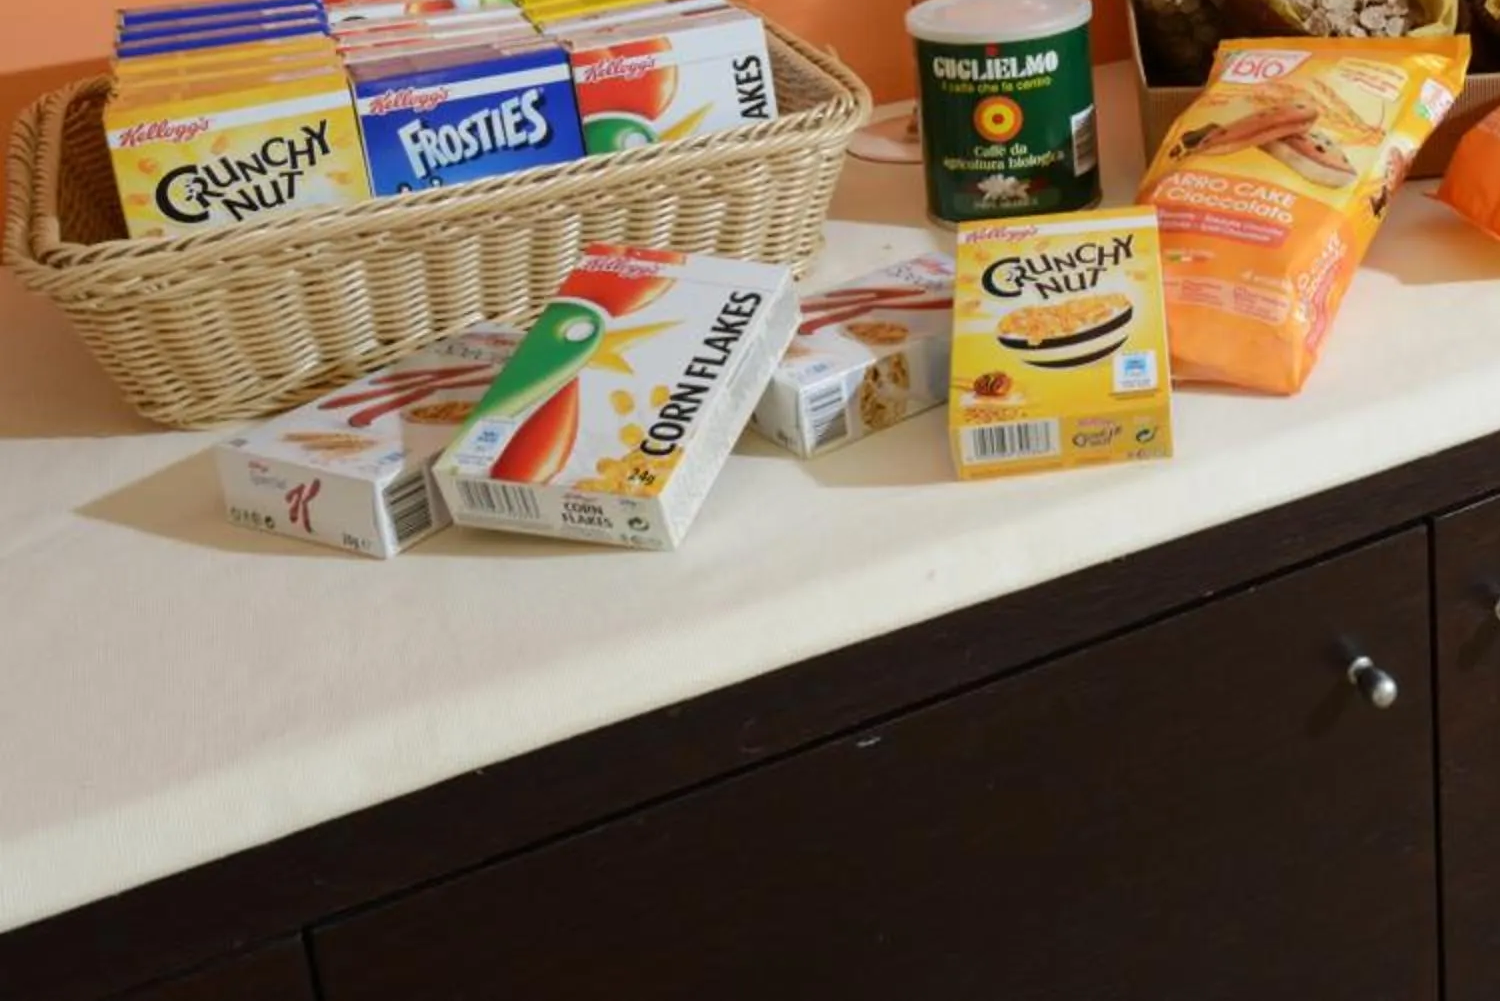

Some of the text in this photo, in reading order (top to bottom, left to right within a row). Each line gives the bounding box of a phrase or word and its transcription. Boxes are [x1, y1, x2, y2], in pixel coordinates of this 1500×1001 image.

[733, 55, 769, 120] AKES
[1231, 57, 1284, 79] bio
[119, 118, 211, 147] Kellogg's
[397, 88, 549, 180] FROSTIES
[155, 119, 331, 224] CRUNCHY
[221, 171, 304, 222] NUT
[981, 234, 1134, 298] CRUNCHY
[1035, 267, 1108, 300] NUT
[639, 382, 711, 457] CORN
[684, 290, 763, 381] FLAKES
[628, 467, 656, 486] 24g
[285, 478, 321, 534] K
